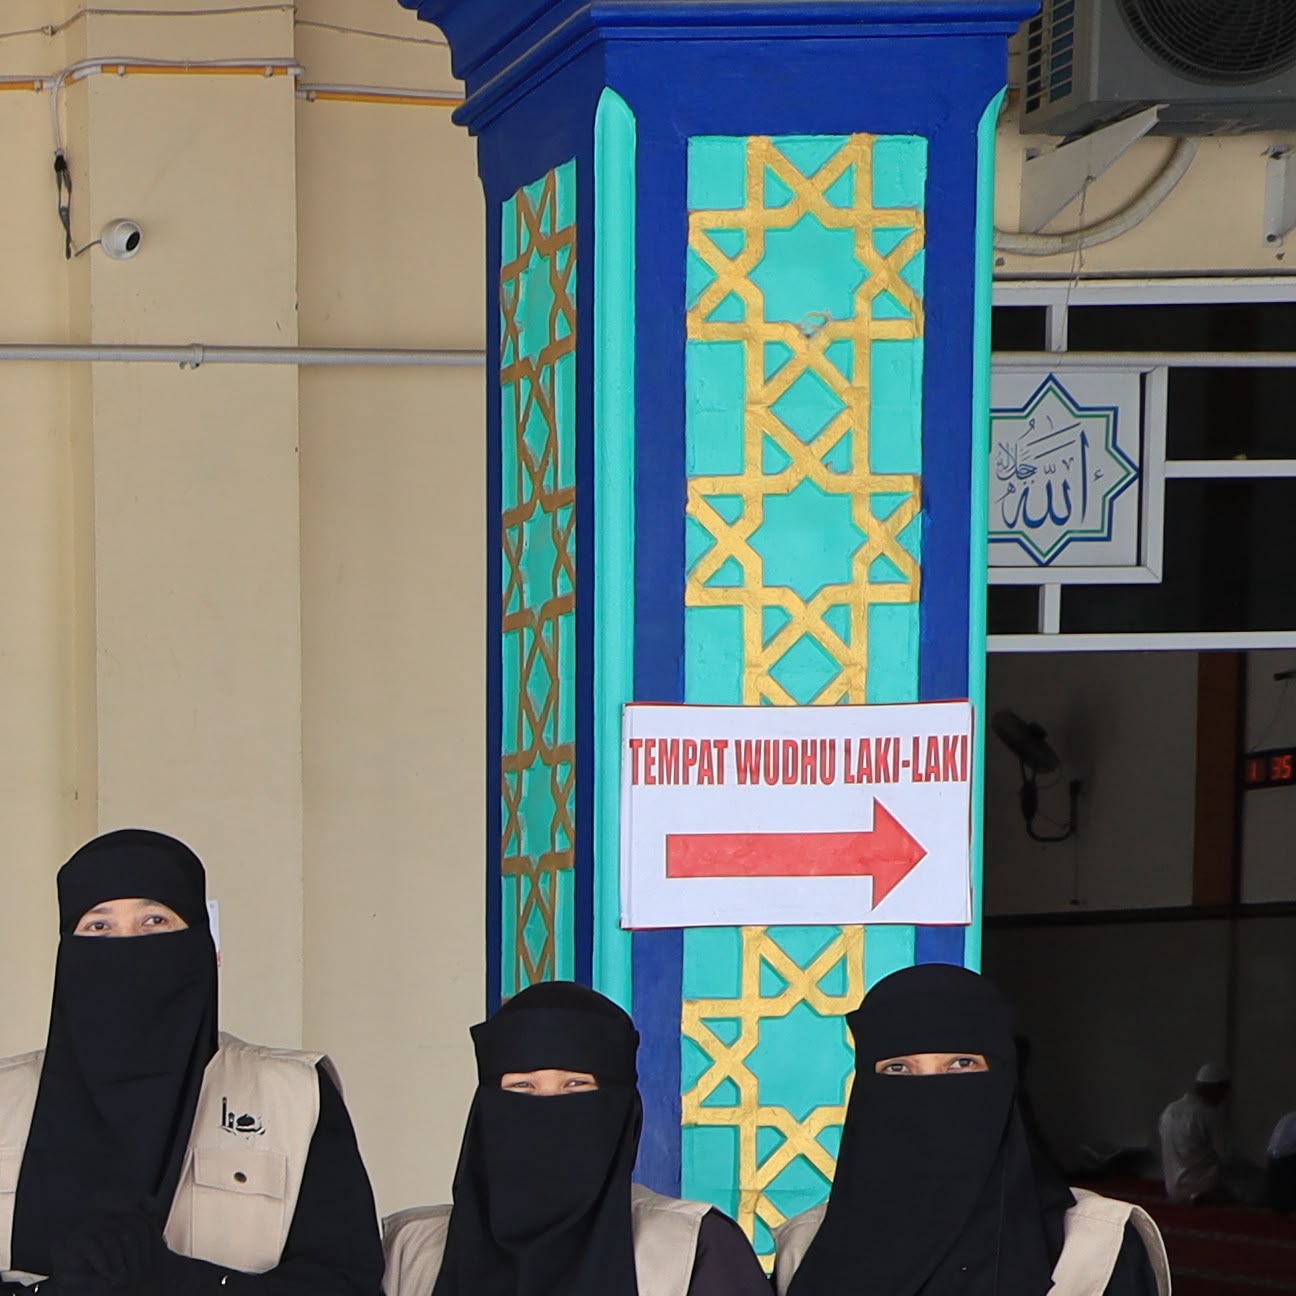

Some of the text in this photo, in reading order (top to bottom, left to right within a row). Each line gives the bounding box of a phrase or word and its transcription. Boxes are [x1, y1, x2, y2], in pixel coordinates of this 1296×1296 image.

[629, 735, 968, 786] TEMPAT WUDHU LAKI-LAKI
